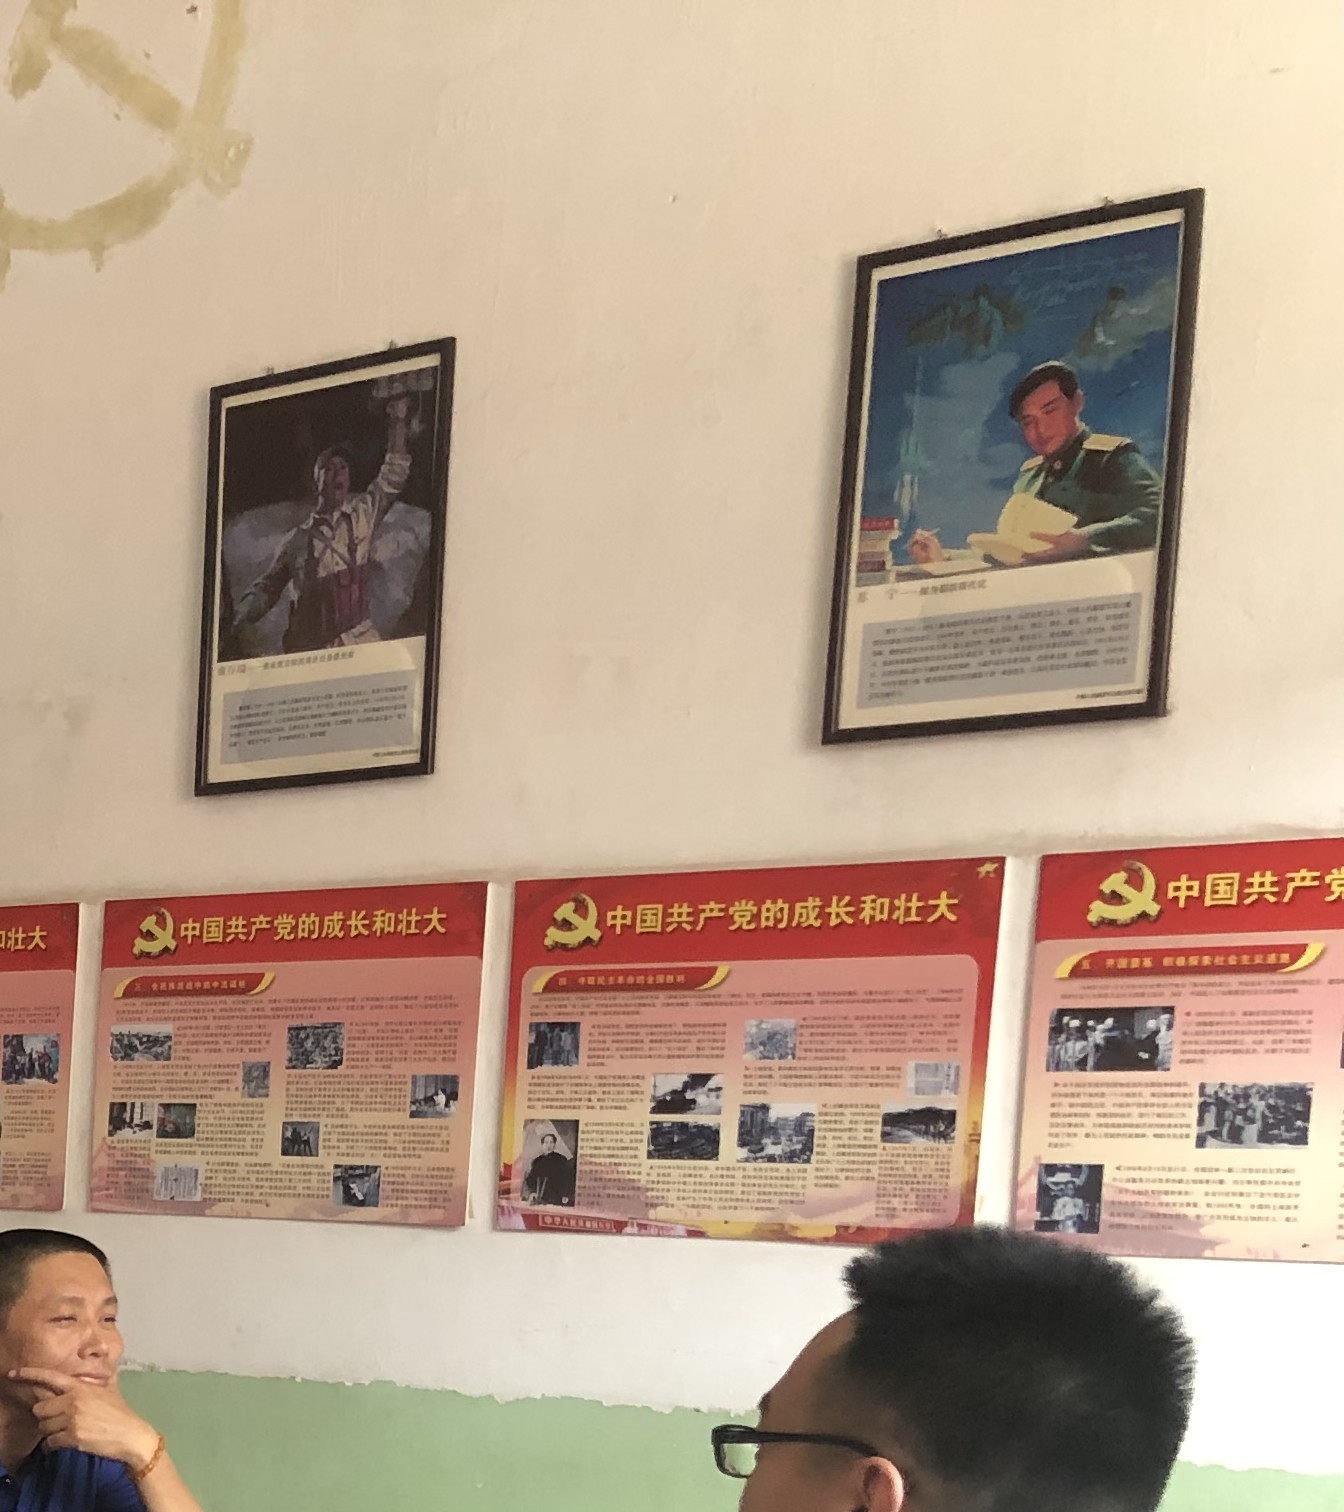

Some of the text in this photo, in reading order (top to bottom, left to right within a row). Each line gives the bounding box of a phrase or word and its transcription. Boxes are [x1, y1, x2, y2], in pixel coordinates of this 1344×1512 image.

[180, 907, 447, 944] 中国共产党的成长和壮大
[606, 891, 959, 934] 中国共产党的成长和壮大
